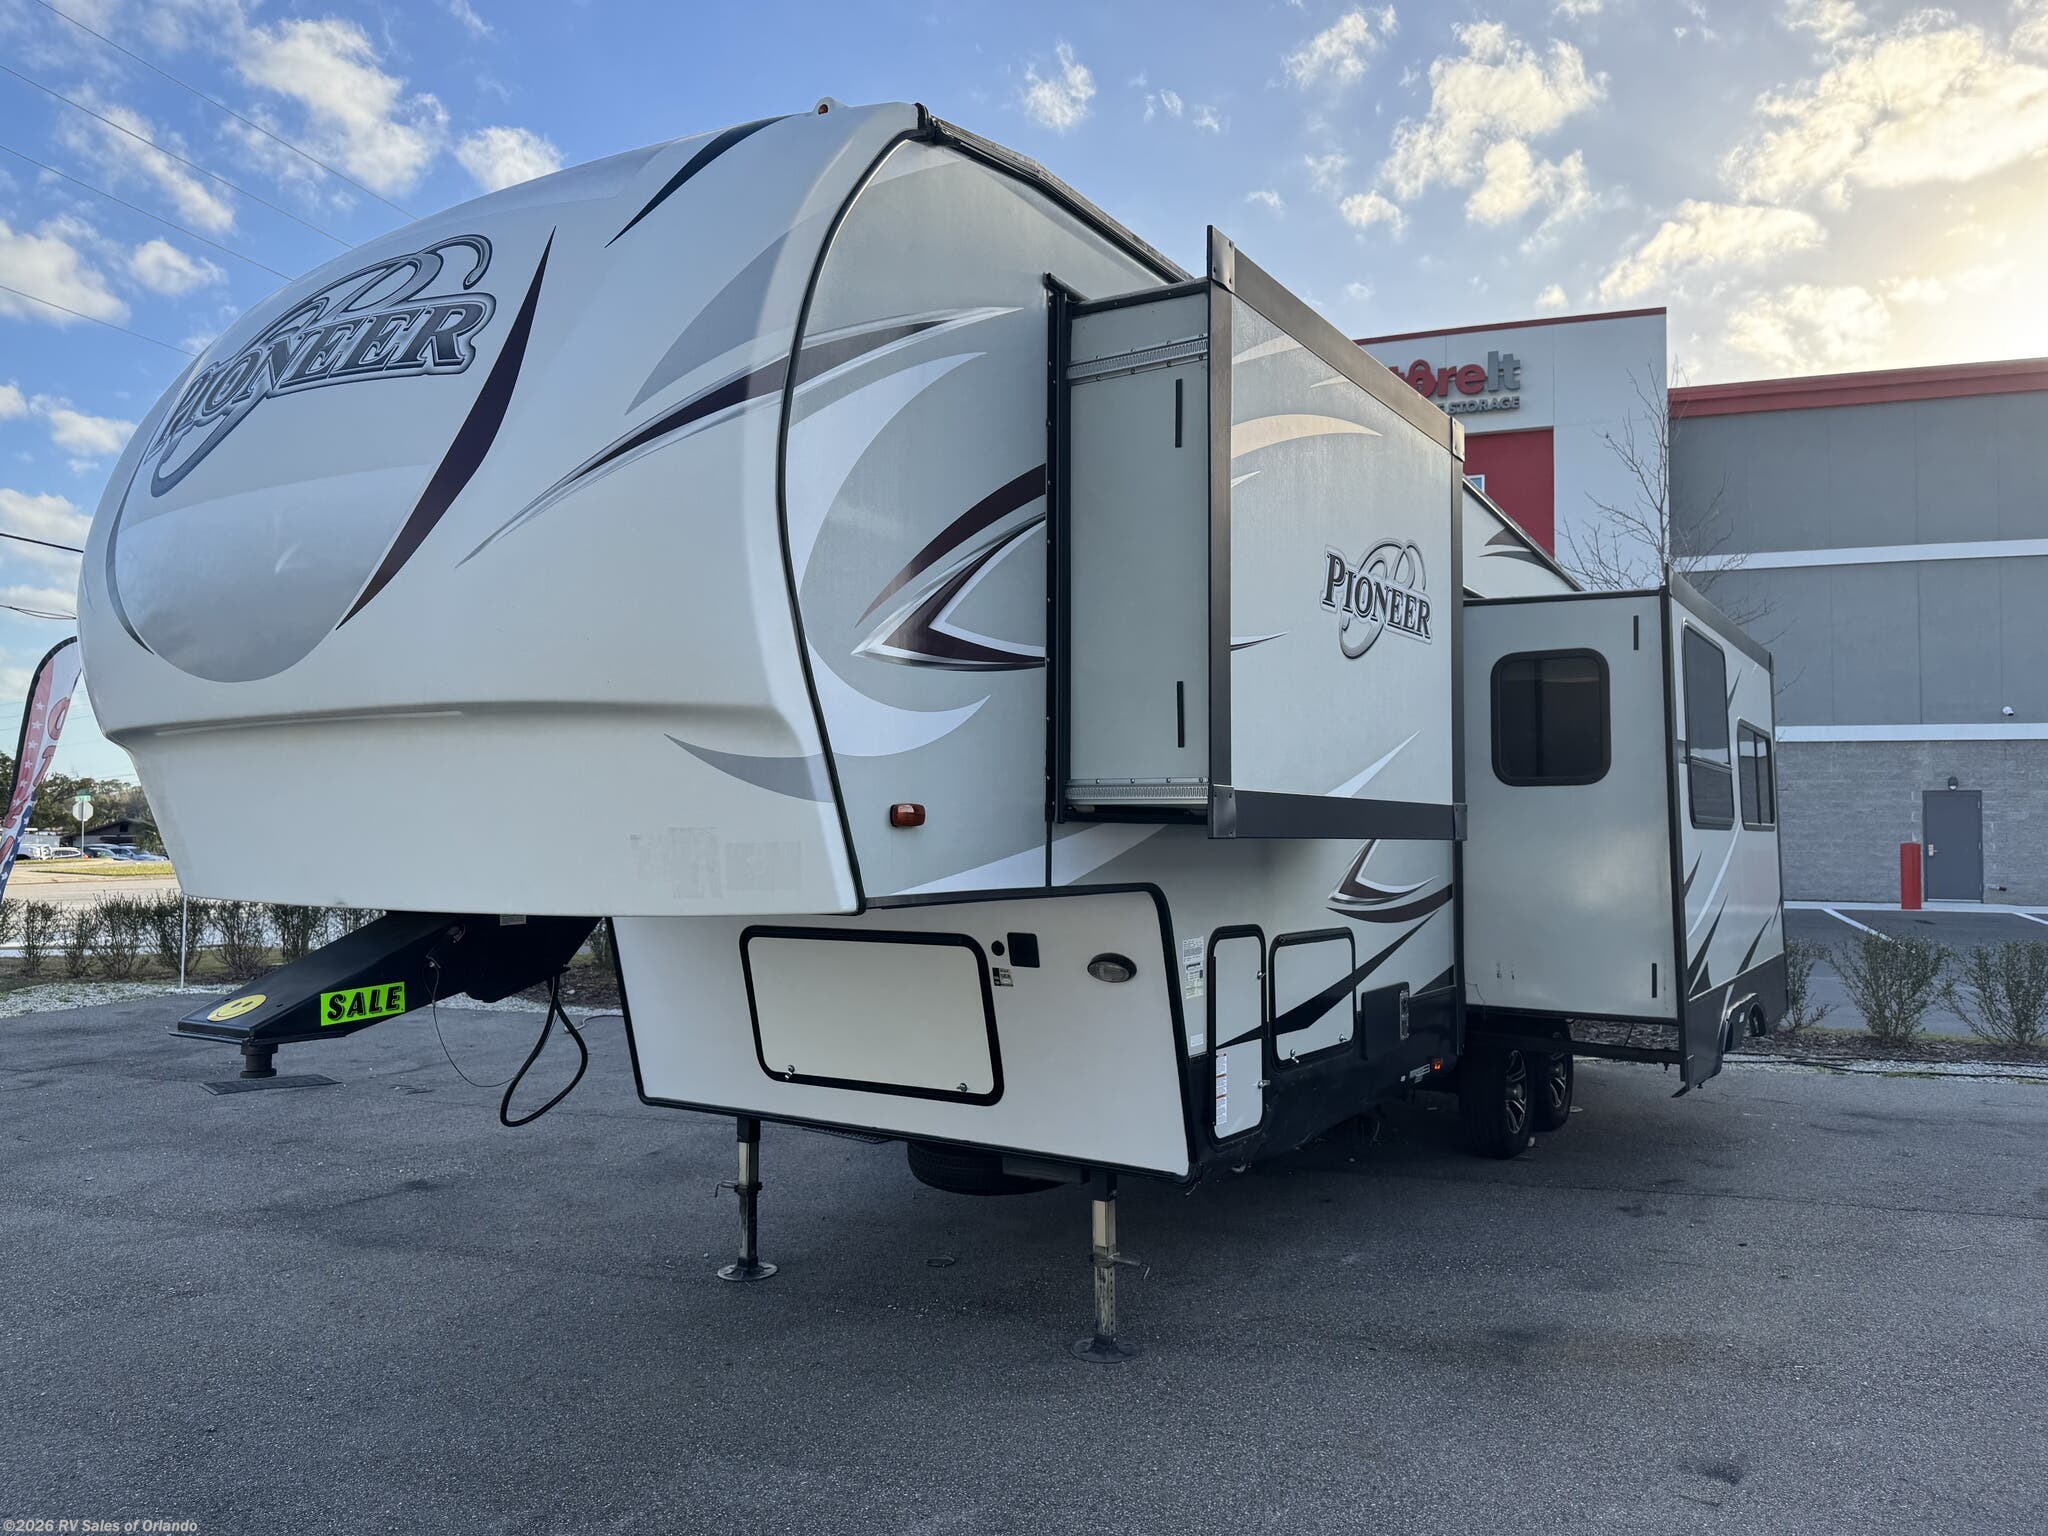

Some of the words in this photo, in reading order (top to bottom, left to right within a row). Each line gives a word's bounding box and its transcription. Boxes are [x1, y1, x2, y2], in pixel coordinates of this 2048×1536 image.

[146, 296, 496, 460] PIONEER
[1389, 351, 1521, 398] oreIt
[1448, 396, 1520, 414] STORAGE
[1322, 551, 1431, 640] PIONEER
[327, 986, 402, 1021] SALE
